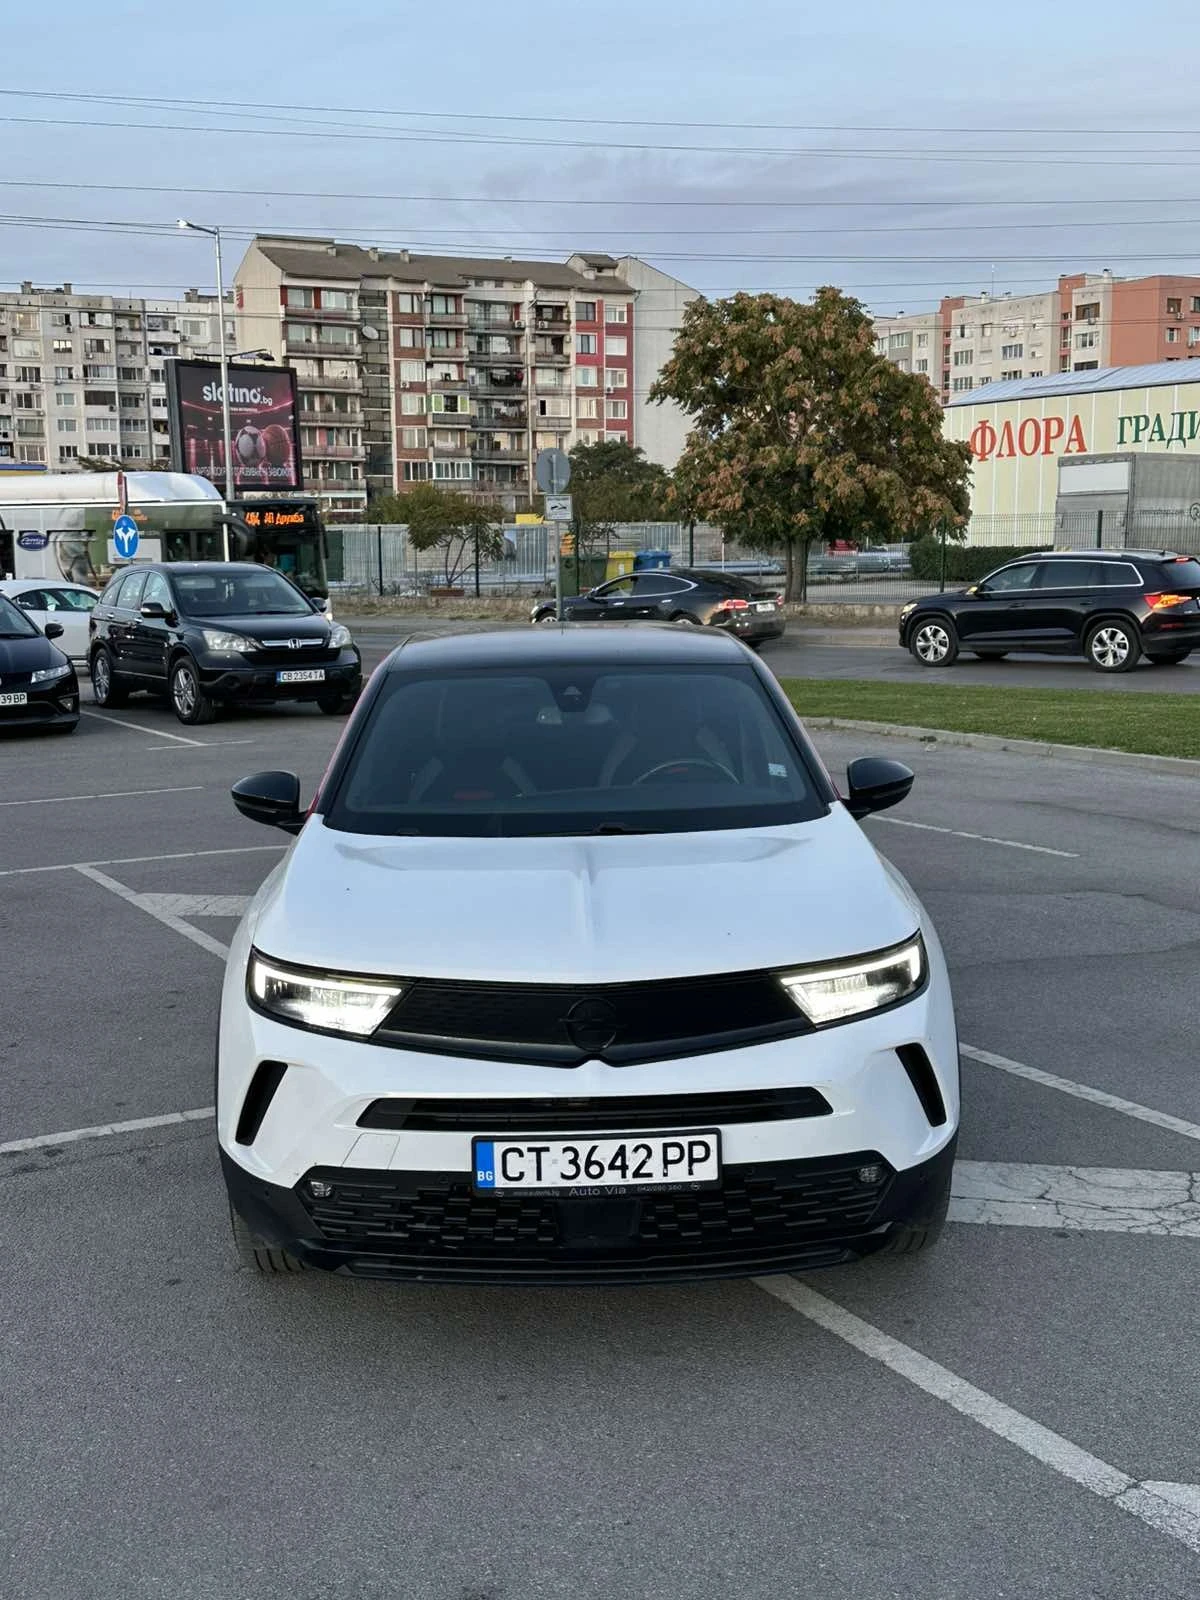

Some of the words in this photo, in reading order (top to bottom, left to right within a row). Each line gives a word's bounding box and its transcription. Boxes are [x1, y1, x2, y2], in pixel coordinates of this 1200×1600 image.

[970, 414, 1087, 462] ФЛОРА
[501, 1146, 550, 1182] CT
[560, 1143, 654, 1181] 3642
[662, 1140, 711, 1177] PP
[477, 1170, 494, 1182] BG
[568, 1187, 601, 1197] Auto
[604, 1186, 627, 1195] Via
